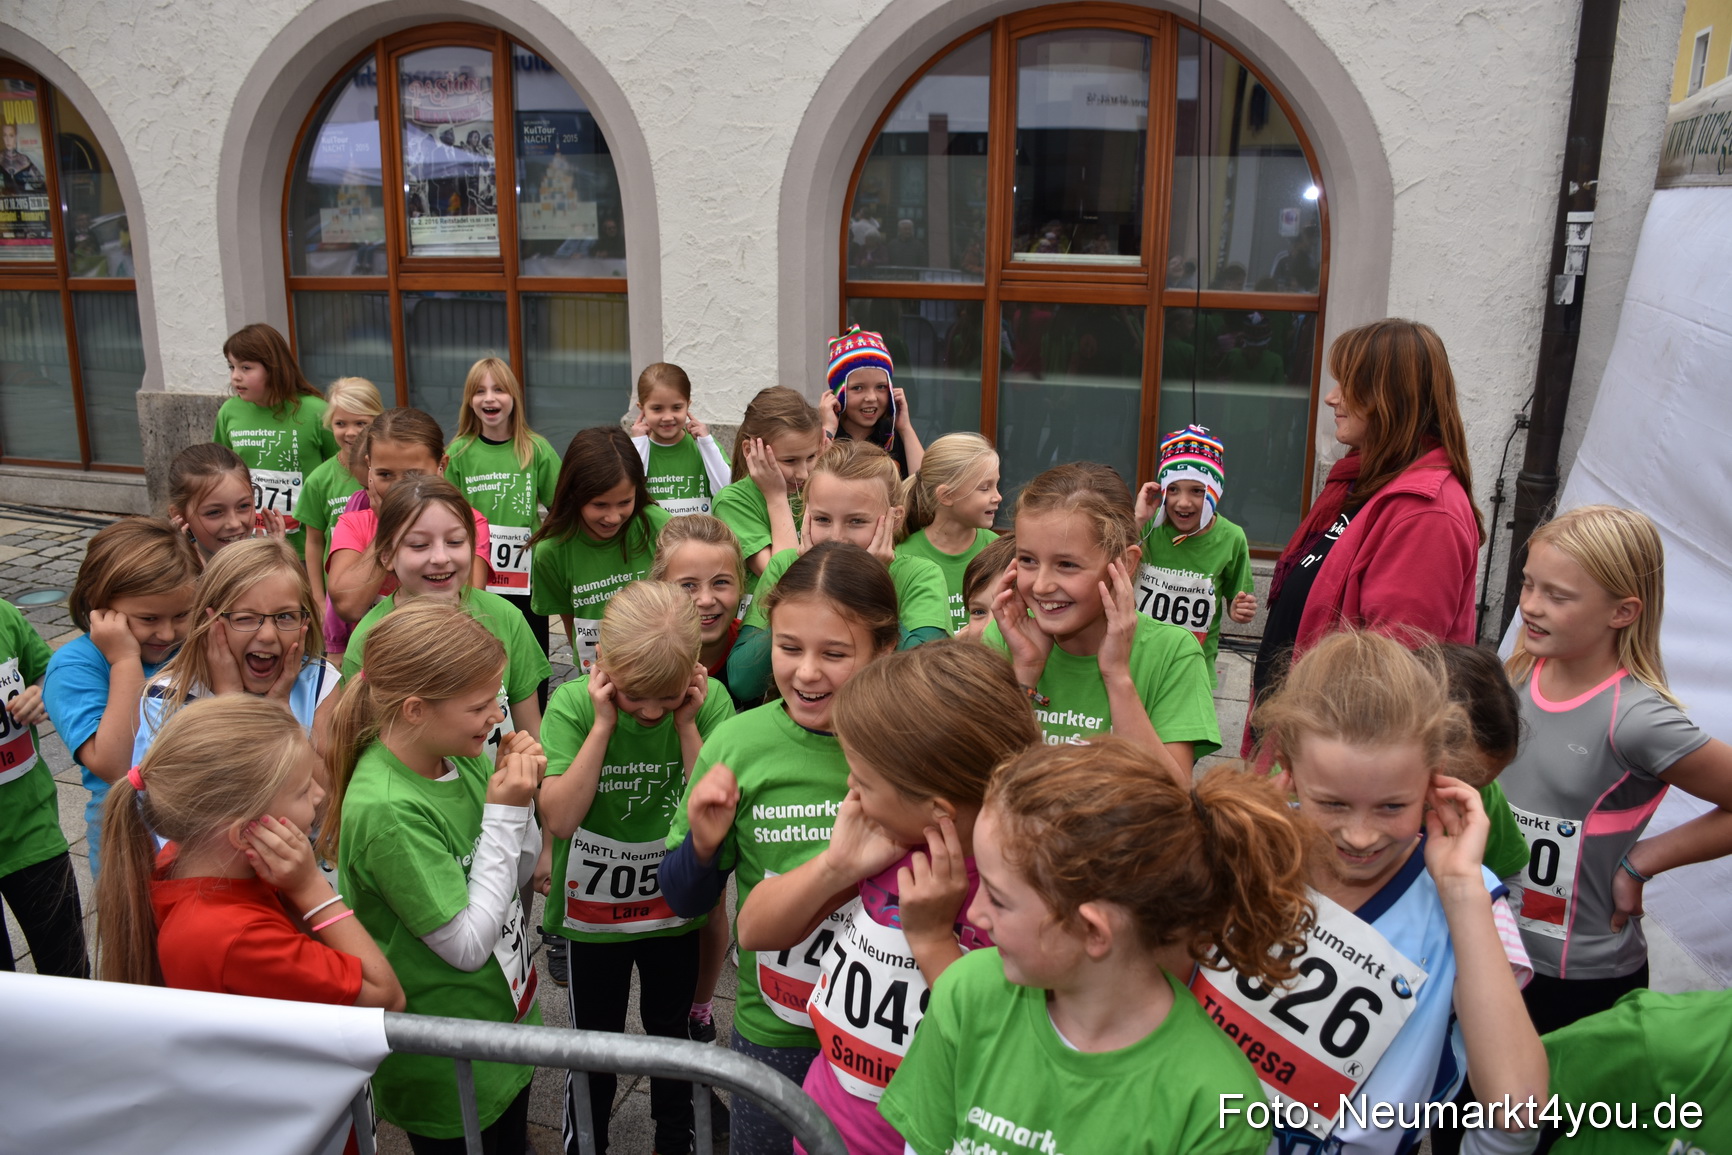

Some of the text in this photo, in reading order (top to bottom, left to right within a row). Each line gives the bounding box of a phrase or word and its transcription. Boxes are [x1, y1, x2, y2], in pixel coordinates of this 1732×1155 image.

[523, 126, 556, 134] KulTour
[524, 134, 579, 143] NACHT 2015
[1161, 581, 1205, 594] Neumarkt
[1139, 585, 1210, 628] 7069
[578, 627, 598, 636] PART
[1034, 709, 1103, 730] markter
[601, 762, 661, 777] markter
[1512, 811, 1550, 831] markt
[754, 824, 833, 843] Stadtlau
[574, 838, 668, 861] PARTL Neuma
[583, 859, 660, 899] 705
[613, 906, 650, 920] Lara
[859, 934, 920, 970] Neuma
[1306, 925, 1386, 980] umarkt
[832, 1034, 897, 1084] Samin
